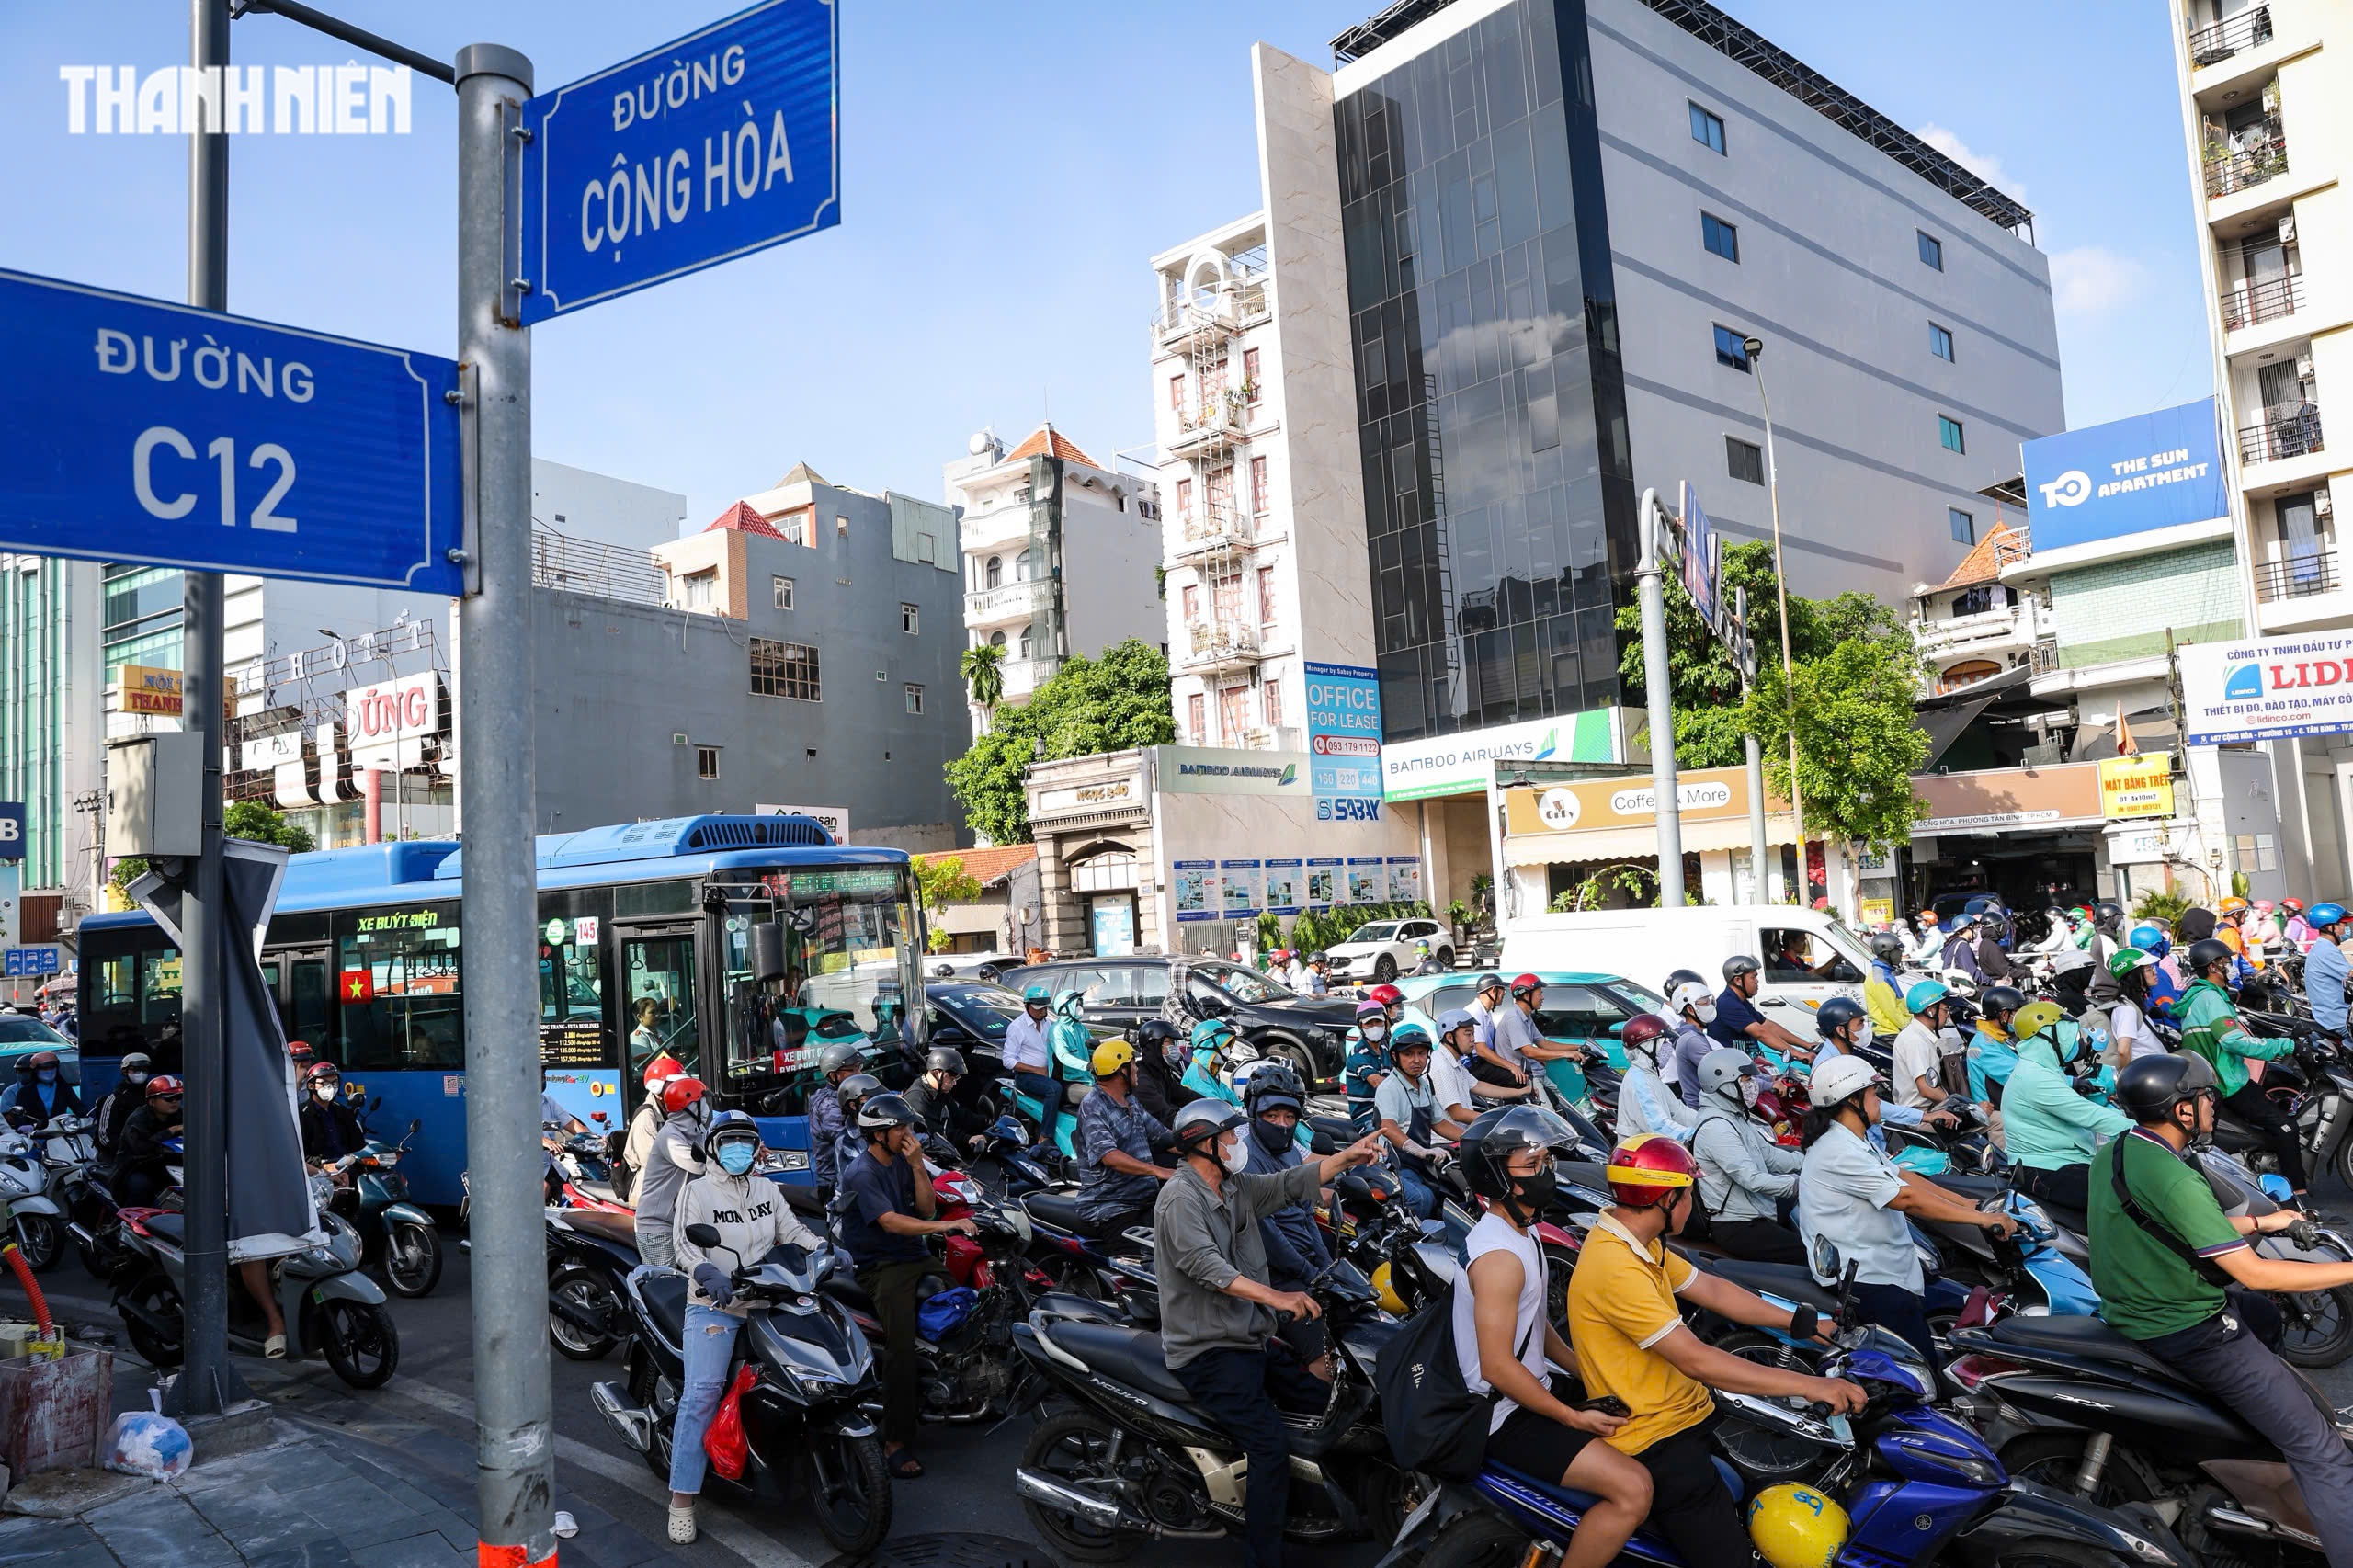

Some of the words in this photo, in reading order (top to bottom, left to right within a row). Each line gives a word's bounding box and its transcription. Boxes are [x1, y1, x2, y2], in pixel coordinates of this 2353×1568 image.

[613, 44, 745, 131] ĐƯỜNG
[582, 148, 690, 263] CỘNG
[705, 99, 794, 213] HÒA
[94, 327, 314, 403] ĐƯỜNG
[2111, 457, 2148, 476] THE
[2151, 448, 2189, 469] SUN
[133, 426, 298, 533] C12
[2098, 462, 2209, 497] APARTMENT
[2227, 648, 2255, 660] CÔNG
[2257, 647, 2269, 658] TY
[2272, 645, 2301, 656] TNHH
[2303, 639, 2325, 653] ĐẦU
[2329, 639, 2342, 651] TƯ
[1306, 665, 1328, 675] Manager
[1336, 668, 1352, 676] Sabay
[1353, 670, 1374, 678] Property
[1308, 684, 1376, 710] OFFICE
[2204, 702, 2232, 716] THIẾT
[2234, 705, 2244, 715] BỊ
[2265, 699, 2286, 711] ĐÀO
[2313, 695, 2336, 708] MÁY
[1311, 710, 1336, 727] FOR
[1340, 713, 1379, 730] LEASE
[2257, 713, 2311, 724] lidinco.com
[1328, 741, 1342, 751] 093
[1345, 743, 1358, 751] 179
[1359, 743, 1377, 753] 1122
[1390, 754, 1456, 775] BAMBOO
[1463, 742, 1534, 763] AIRWAYS
[1178, 764, 1230, 776] BAMBOO
[1230, 766, 1283, 778] AIRWAYS
[1317, 773, 1334, 785] 160
[1339, 774, 1356, 785] 220
[1335, 798, 1381, 821] SABAY
[1614, 794, 1655, 811] Coffe
[1687, 788, 1727, 804] More
[1958, 816, 1989, 824] PHƯỜNG
[358, 917, 375, 931] XE
[376, 910, 410, 929] BUÝT
[409, 910, 438, 929] ĐIỆN
[578, 922, 596, 939] 145
[2113, 961, 2128, 972] Grab
[784, 1052, 795, 1062] XE
[713, 1210, 745, 1223] MON
[747, 1200, 773, 1221] DAY
[2053, 1393, 2115, 1411] PCX
